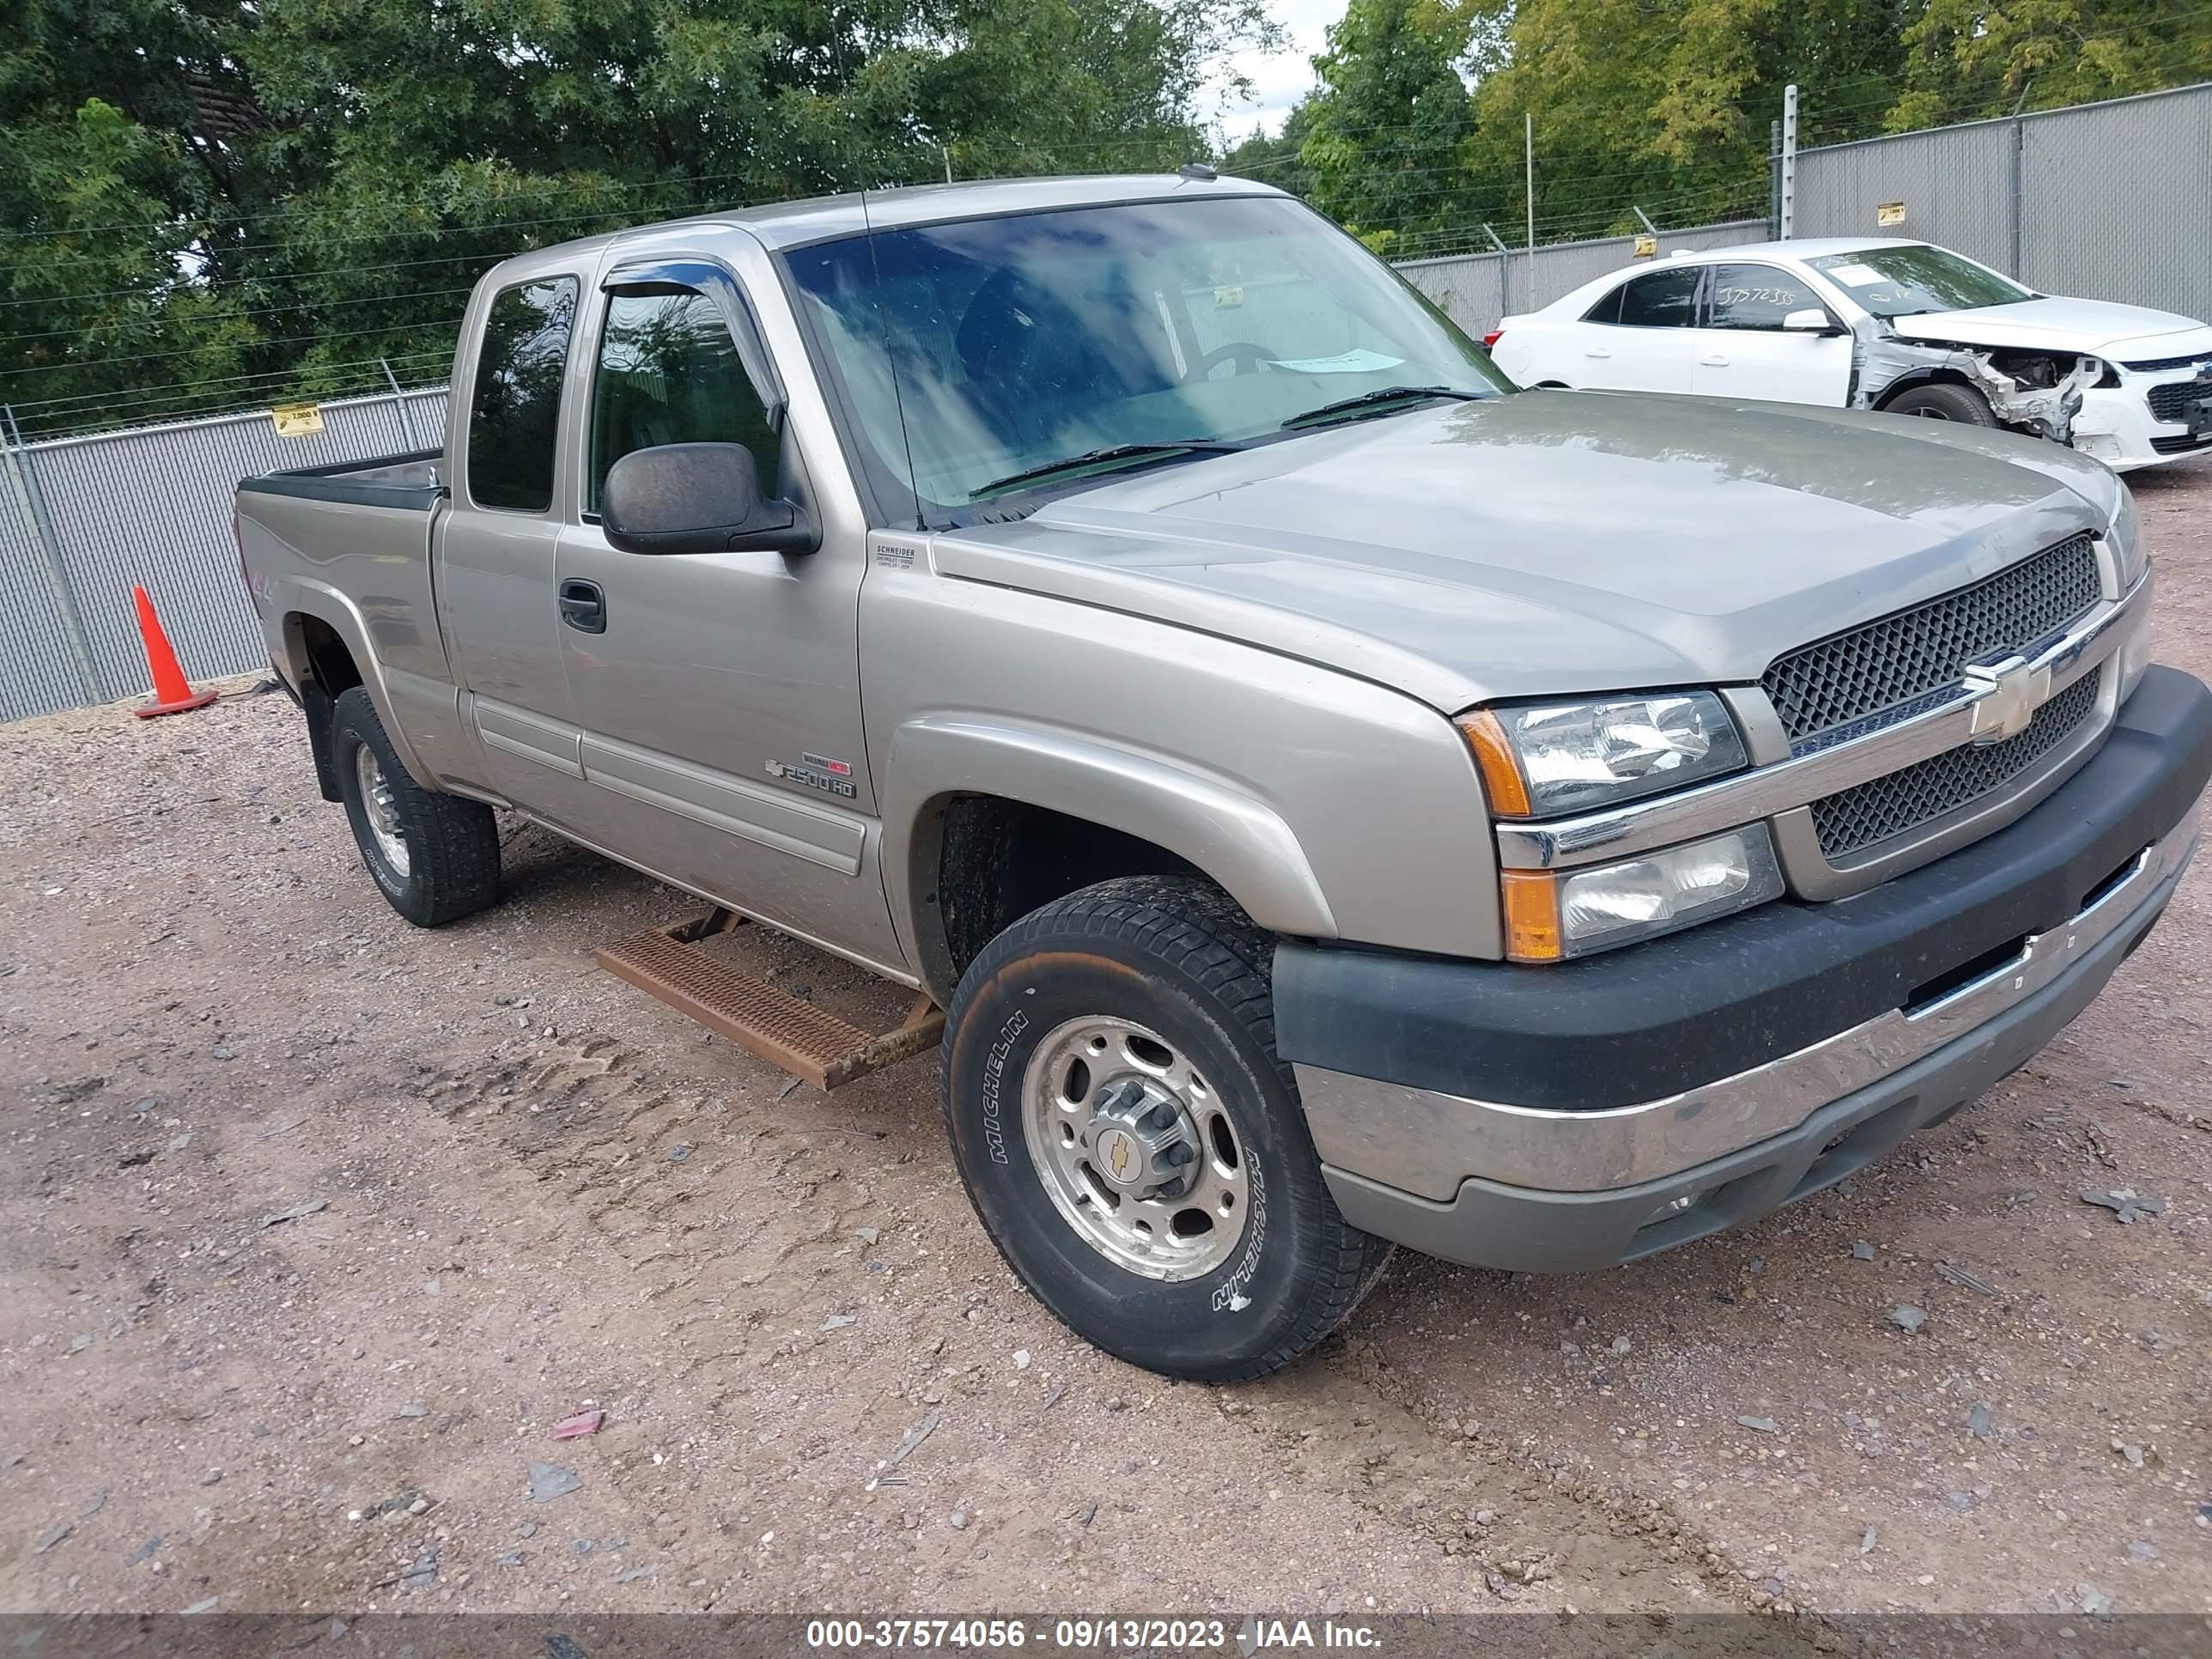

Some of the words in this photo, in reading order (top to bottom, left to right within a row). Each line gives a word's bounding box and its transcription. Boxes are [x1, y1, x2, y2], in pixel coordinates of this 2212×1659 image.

[1717, 288, 1796, 306] 37572335
[877, 545, 915, 556] SCHNEIDER
[786, 767, 830, 791] 2500
[833, 780, 853, 797] HD
[981, 1009, 1030, 1165] MICHELIN
[1212, 1146, 1271, 1313] MICHELIN
